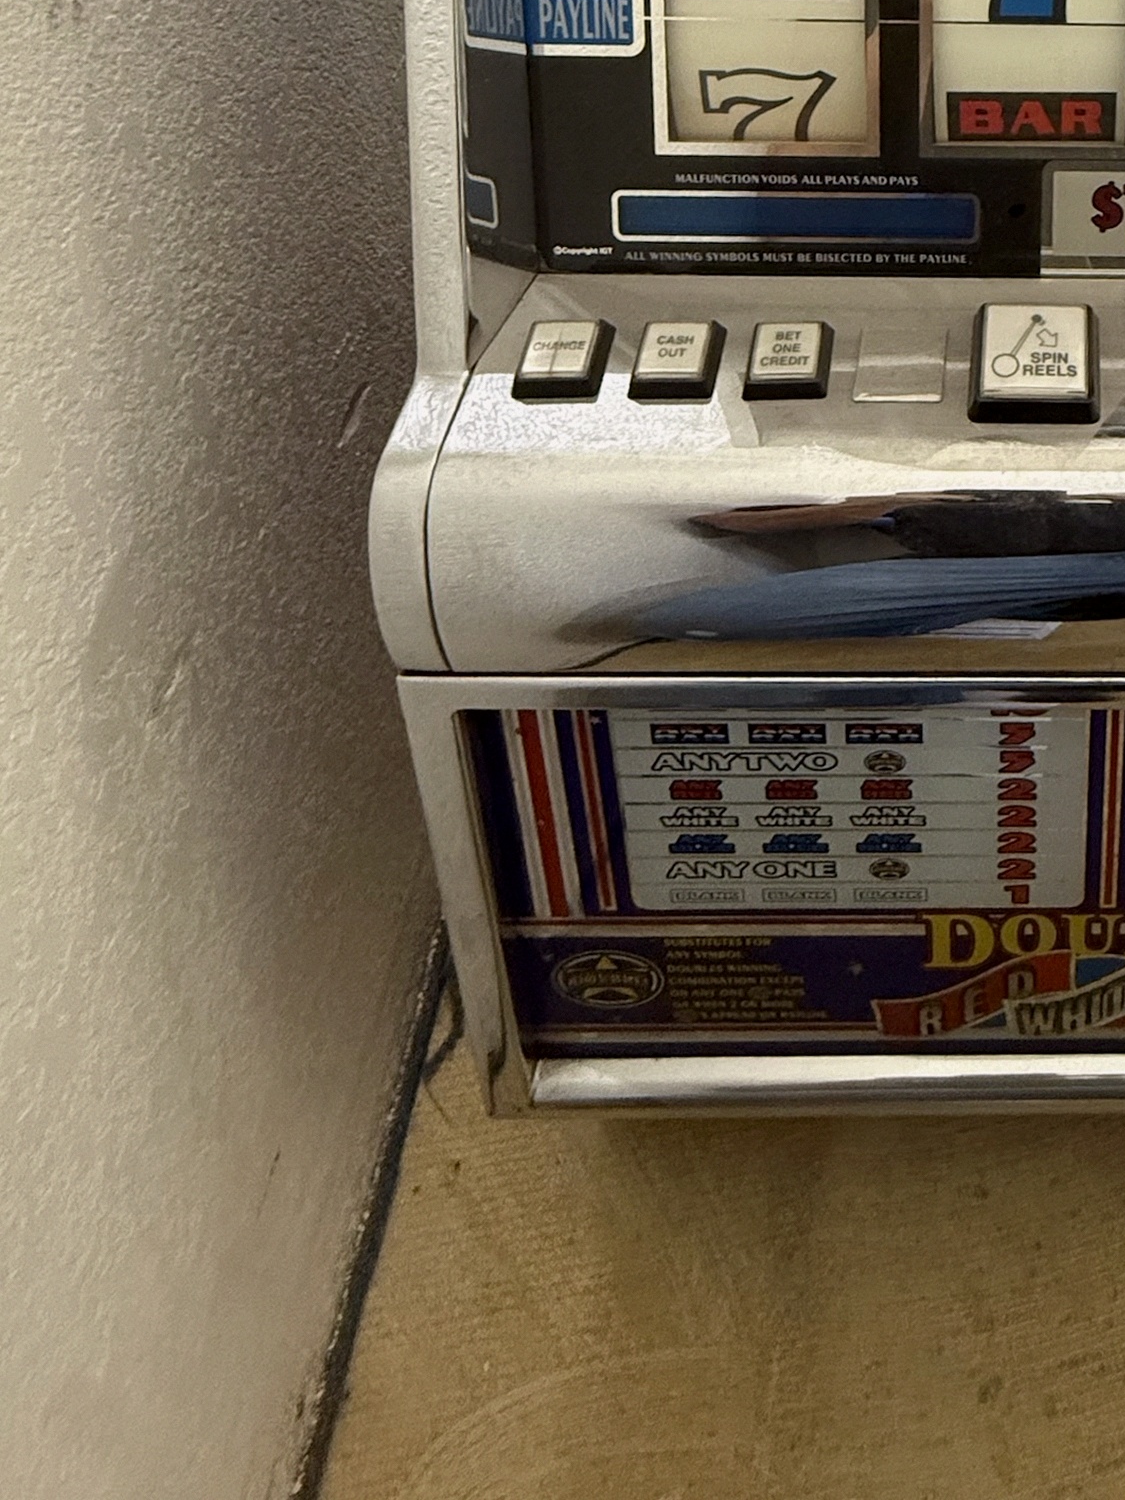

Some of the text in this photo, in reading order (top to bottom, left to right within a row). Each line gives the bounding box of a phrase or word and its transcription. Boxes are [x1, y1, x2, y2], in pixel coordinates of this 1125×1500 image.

[958, 99, 1104, 136] BAR
[675, 173, 919, 187] MALFUNCTION VOIDS ALL PLAYS AND PAYS
[624, 251, 646, 261] ALL
[649, 252, 703, 263] WINNING
[706, 252, 760, 263] SYMBOLS
[762, 252, 794, 263] MUST
[797, 253, 812, 263] BE
[815, 253, 872, 264] BISECTED
[875, 253, 891, 264] BY
[894, 253, 916, 264] THE
[656, 334, 695, 347] CASH
[774, 330, 801, 343] BET
[532, 338, 587, 353] CHANGE
[658, 346, 687, 359] OUT
[772, 342, 802, 355] ONE
[760, 354, 810, 368] CREDIT
[1029, 350, 1070, 366] SPIN
[1022, 363, 1079, 378] REELS
[919, 970, 1035, 1037] RED
